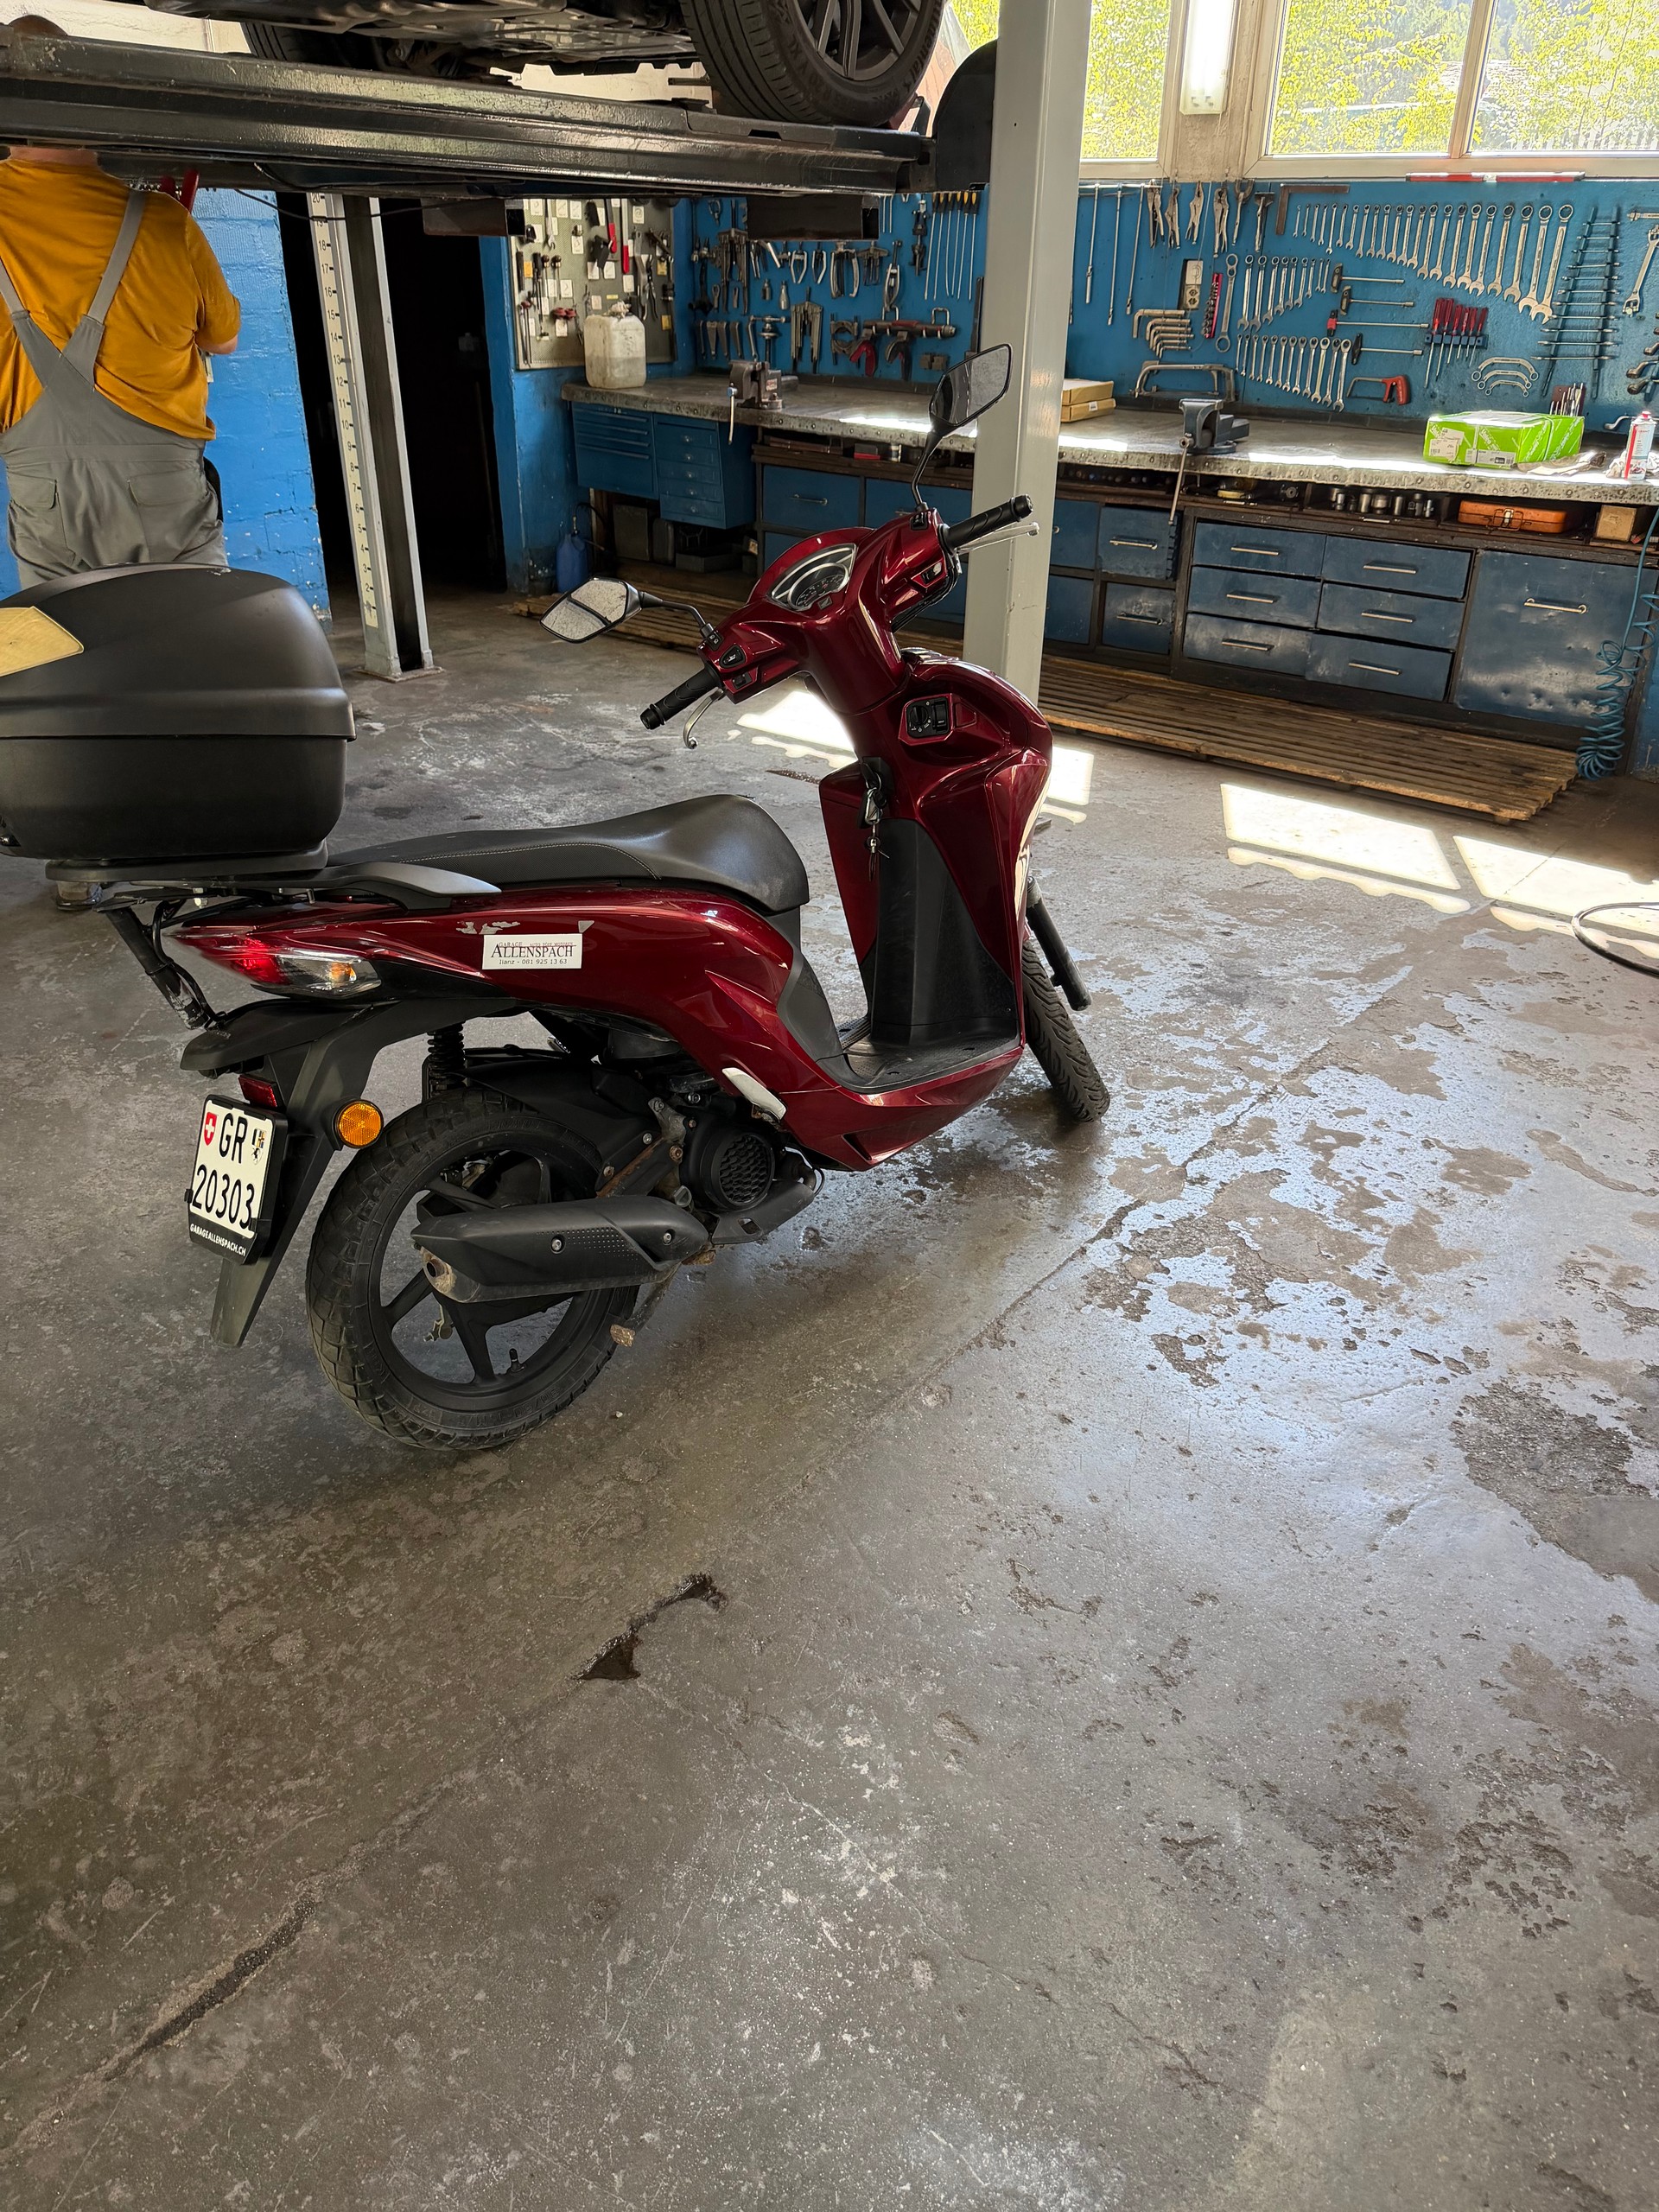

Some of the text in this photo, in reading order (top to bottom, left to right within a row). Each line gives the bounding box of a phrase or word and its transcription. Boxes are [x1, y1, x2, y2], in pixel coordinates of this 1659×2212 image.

[312, 192, 321, 203] 20
[318, 240, 327, 251] 18
[321, 264, 329, 274] 17
[324, 287, 333, 297] 16
[327, 310, 336, 321] 15
[330, 333, 338, 342] 14
[334, 354, 341, 365] 13
[336, 377, 344, 387] 12
[339, 398, 346, 409] 11
[341, 420, 349, 430] 10
[347, 441, 352, 451] 9
[350, 461, 354, 472] 8
[353, 482, 357, 493] 7
[355, 503, 360, 513] 6
[358, 524, 362, 533] 5
[360, 543, 365, 553] 4
[363, 563, 367, 573] 3
[365, 582, 370, 592] 2
[491, 944, 574, 958] ALLENSPACH
[219, 1112, 248, 1164] GR
[192, 1164, 255, 1230] 20303
[189, 1223, 246, 1257] GARAGEALLENSPACH.CH
